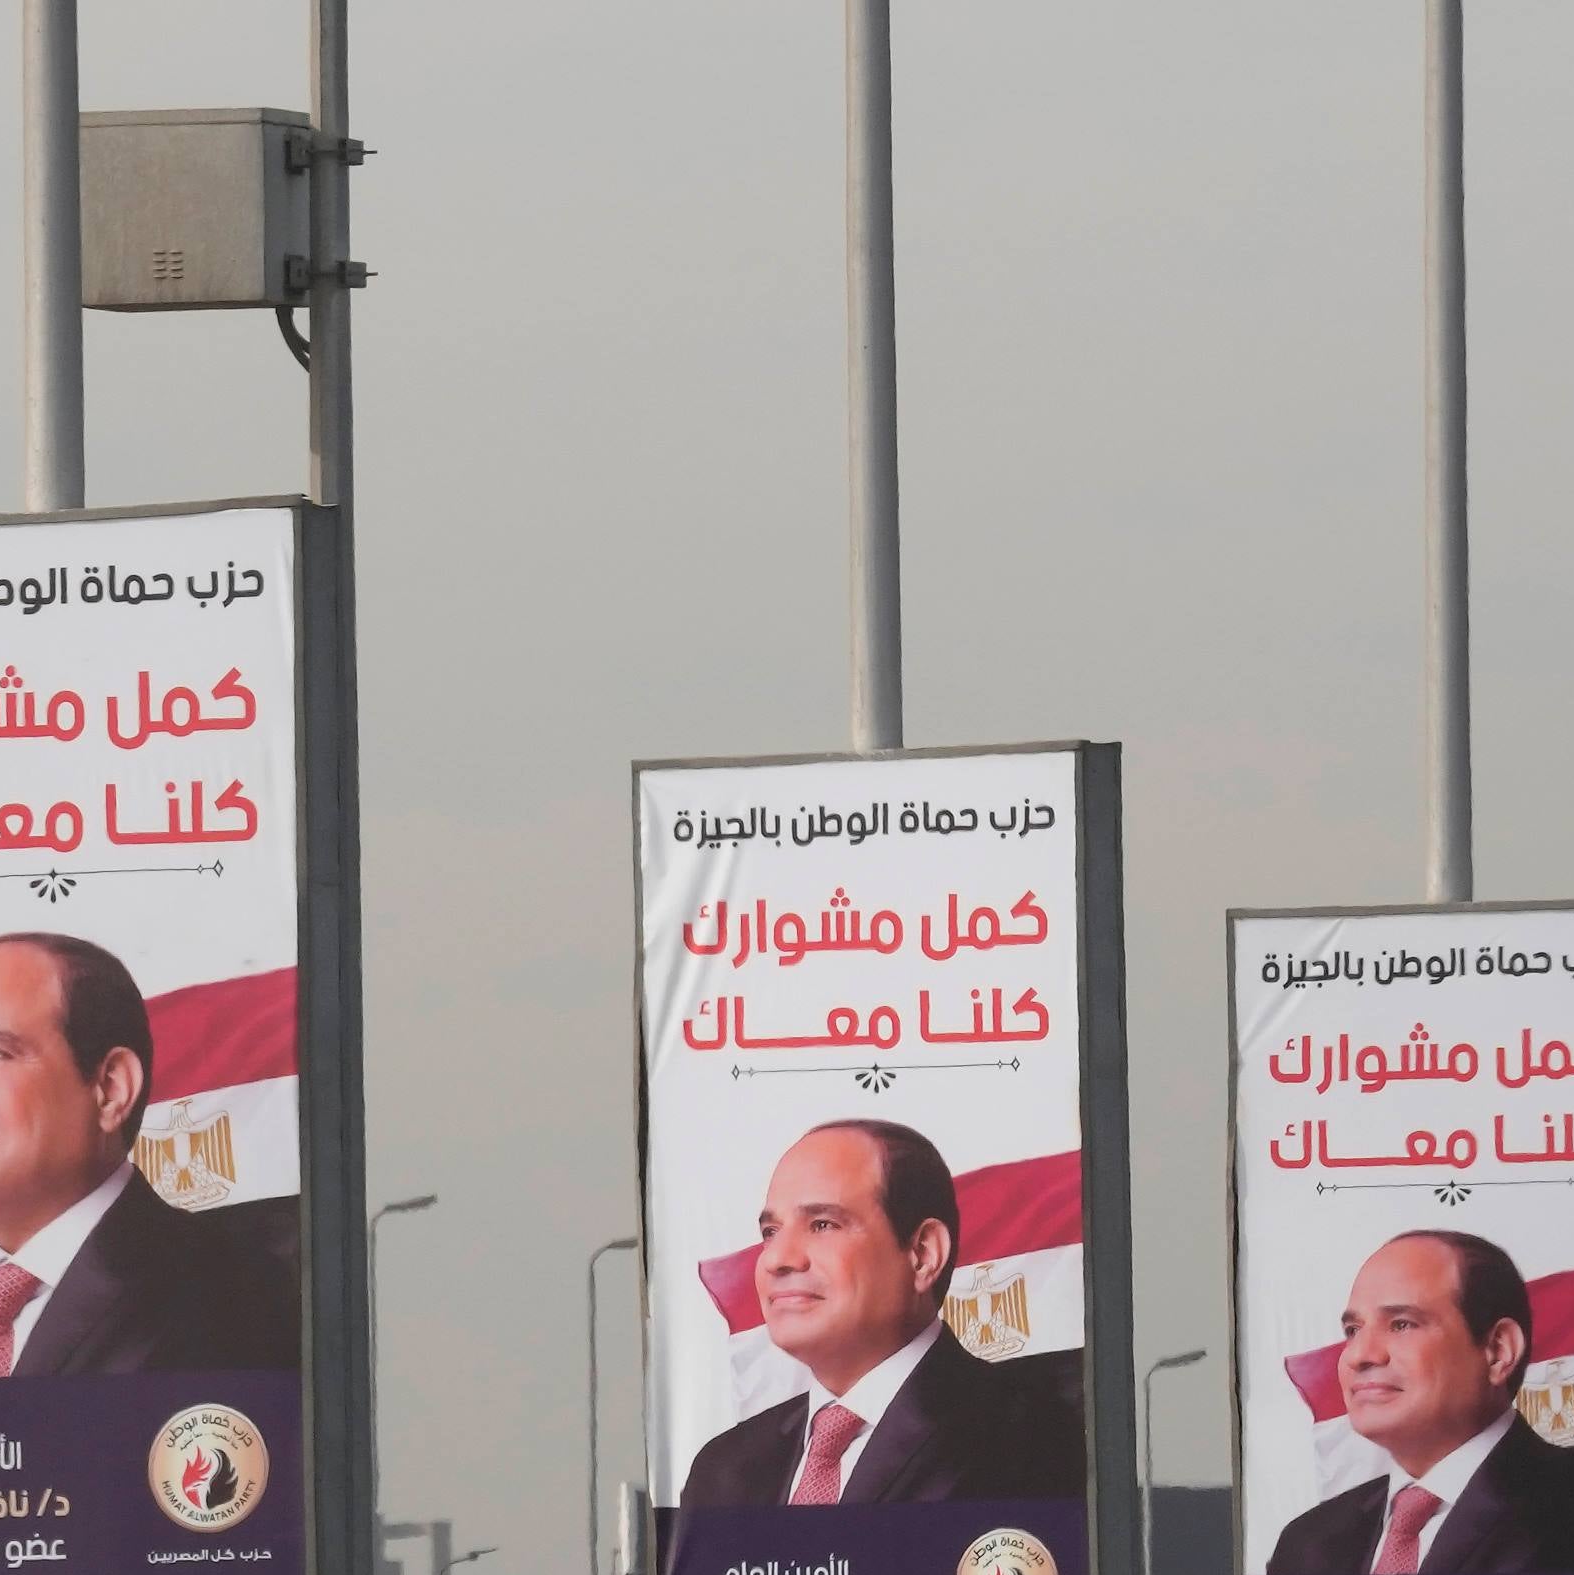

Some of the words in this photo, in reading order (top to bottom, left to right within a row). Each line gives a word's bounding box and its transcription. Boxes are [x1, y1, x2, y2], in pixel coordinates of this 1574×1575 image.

[82, 566, 176, 605] حماة
[188, 562, 264, 608] حزب
[107, 668, 256, 750] كمل
[105, 779, 259, 846] كلنا
[674, 807, 782, 849] بالجيزة
[793, 803, 889, 846] الوطن
[901, 801, 980, 835] حماة
[991, 798, 1055, 838] حزب
[683, 888, 903, 968] مشوارك
[921, 890, 1048, 961] كمل
[1261, 952, 1364, 989] بالجيزة
[1374, 948, 1466, 986] الوطن
[1476, 947, 1551, 977] حماة
[683, 997, 901, 1051] معاك
[920, 986, 1050, 1044] كلنا
[1270, 1023, 1478, 1095] مشوارك
[1270, 1121, 1477, 1169] معاك
[7, 1534, 67, 1568] عضو
[210, 1548, 233, 1560] كل
[239, 1547, 271, 1560] حزب
